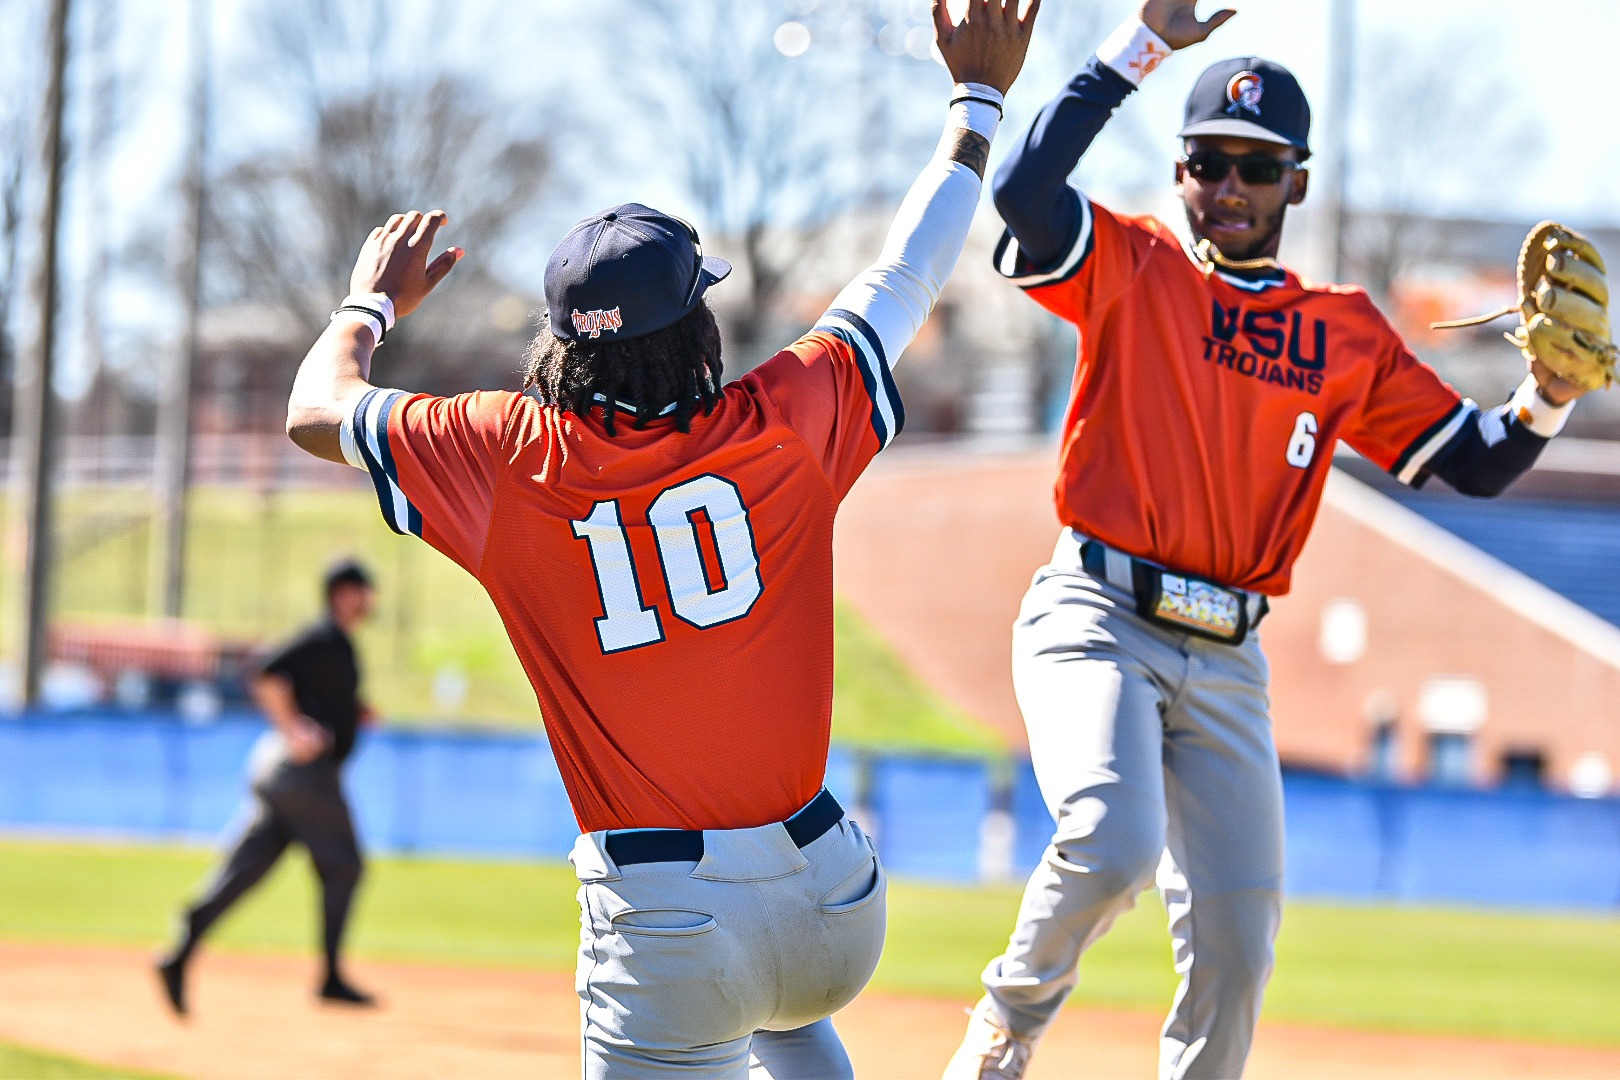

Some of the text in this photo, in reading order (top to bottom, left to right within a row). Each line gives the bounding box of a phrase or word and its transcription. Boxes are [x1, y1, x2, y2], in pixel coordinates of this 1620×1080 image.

[571, 306, 622, 339] TROJANS
[1212, 298, 1327, 370] VSU
[1202, 336, 1324, 396] TROJANS
[1286, 411, 1318, 469] 6
[569, 472, 765, 655] 10
